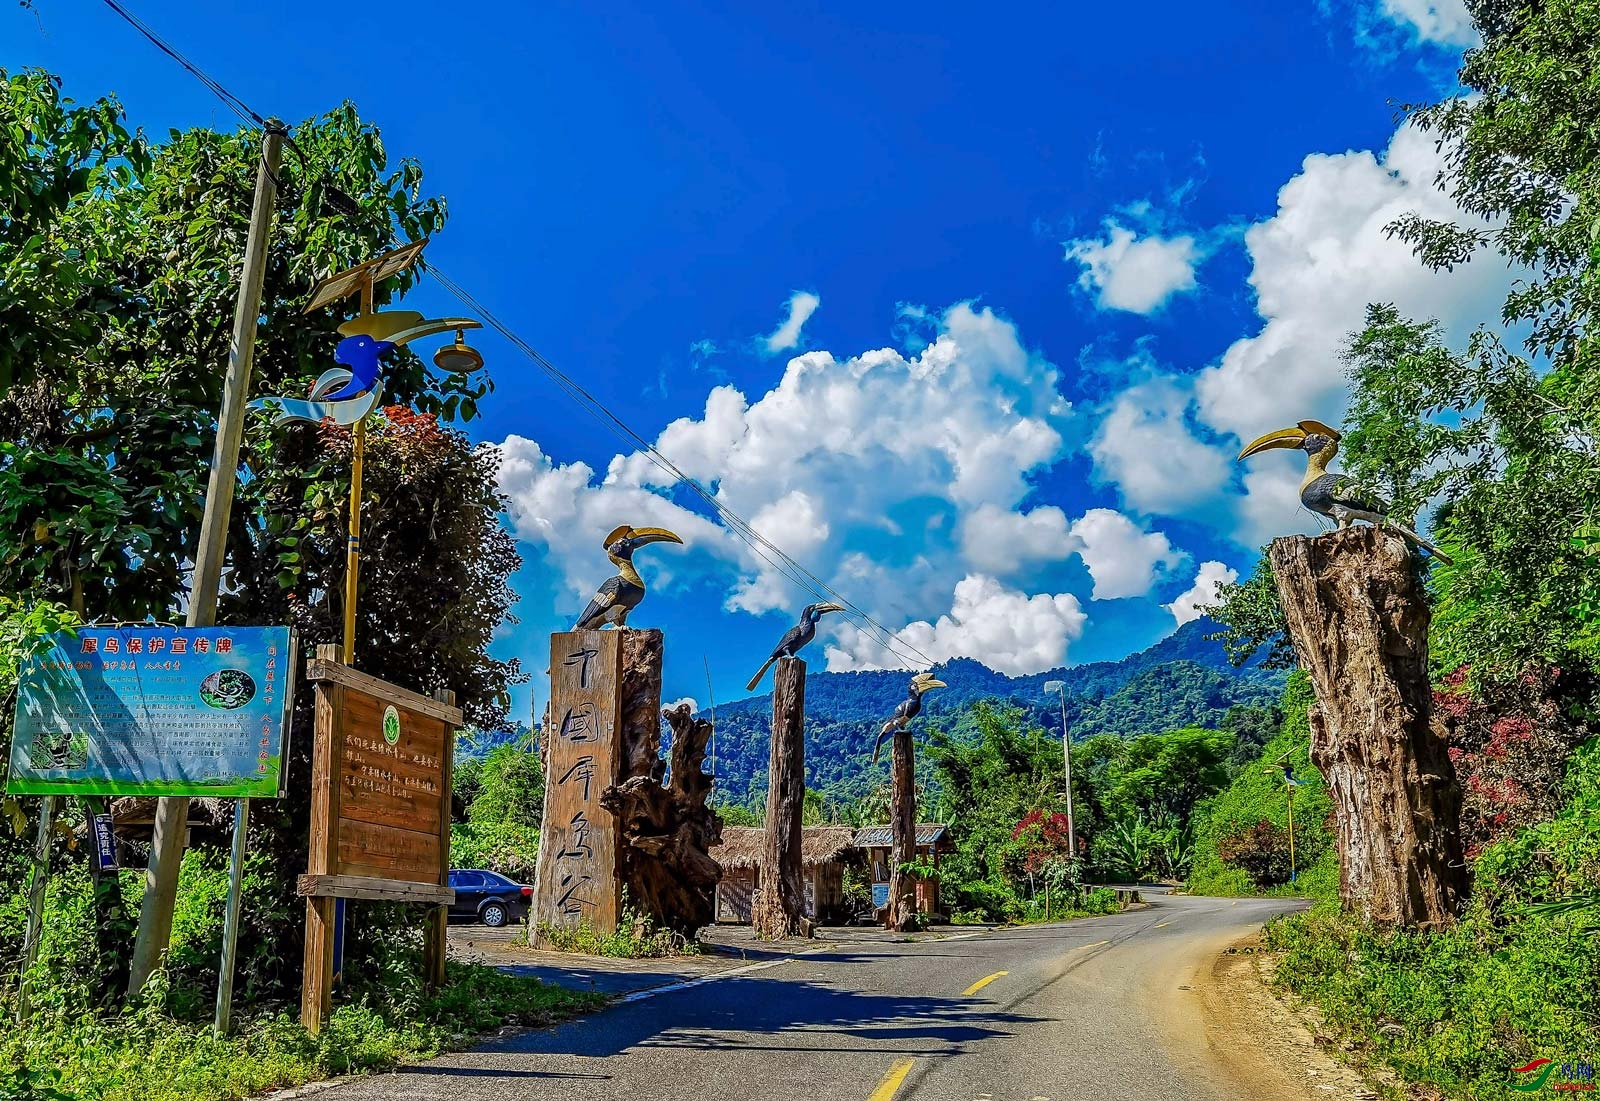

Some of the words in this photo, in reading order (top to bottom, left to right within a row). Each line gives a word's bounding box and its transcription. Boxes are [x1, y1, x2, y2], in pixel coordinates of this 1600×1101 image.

[81, 638, 233, 655] 犀鸟保护宣传牌
